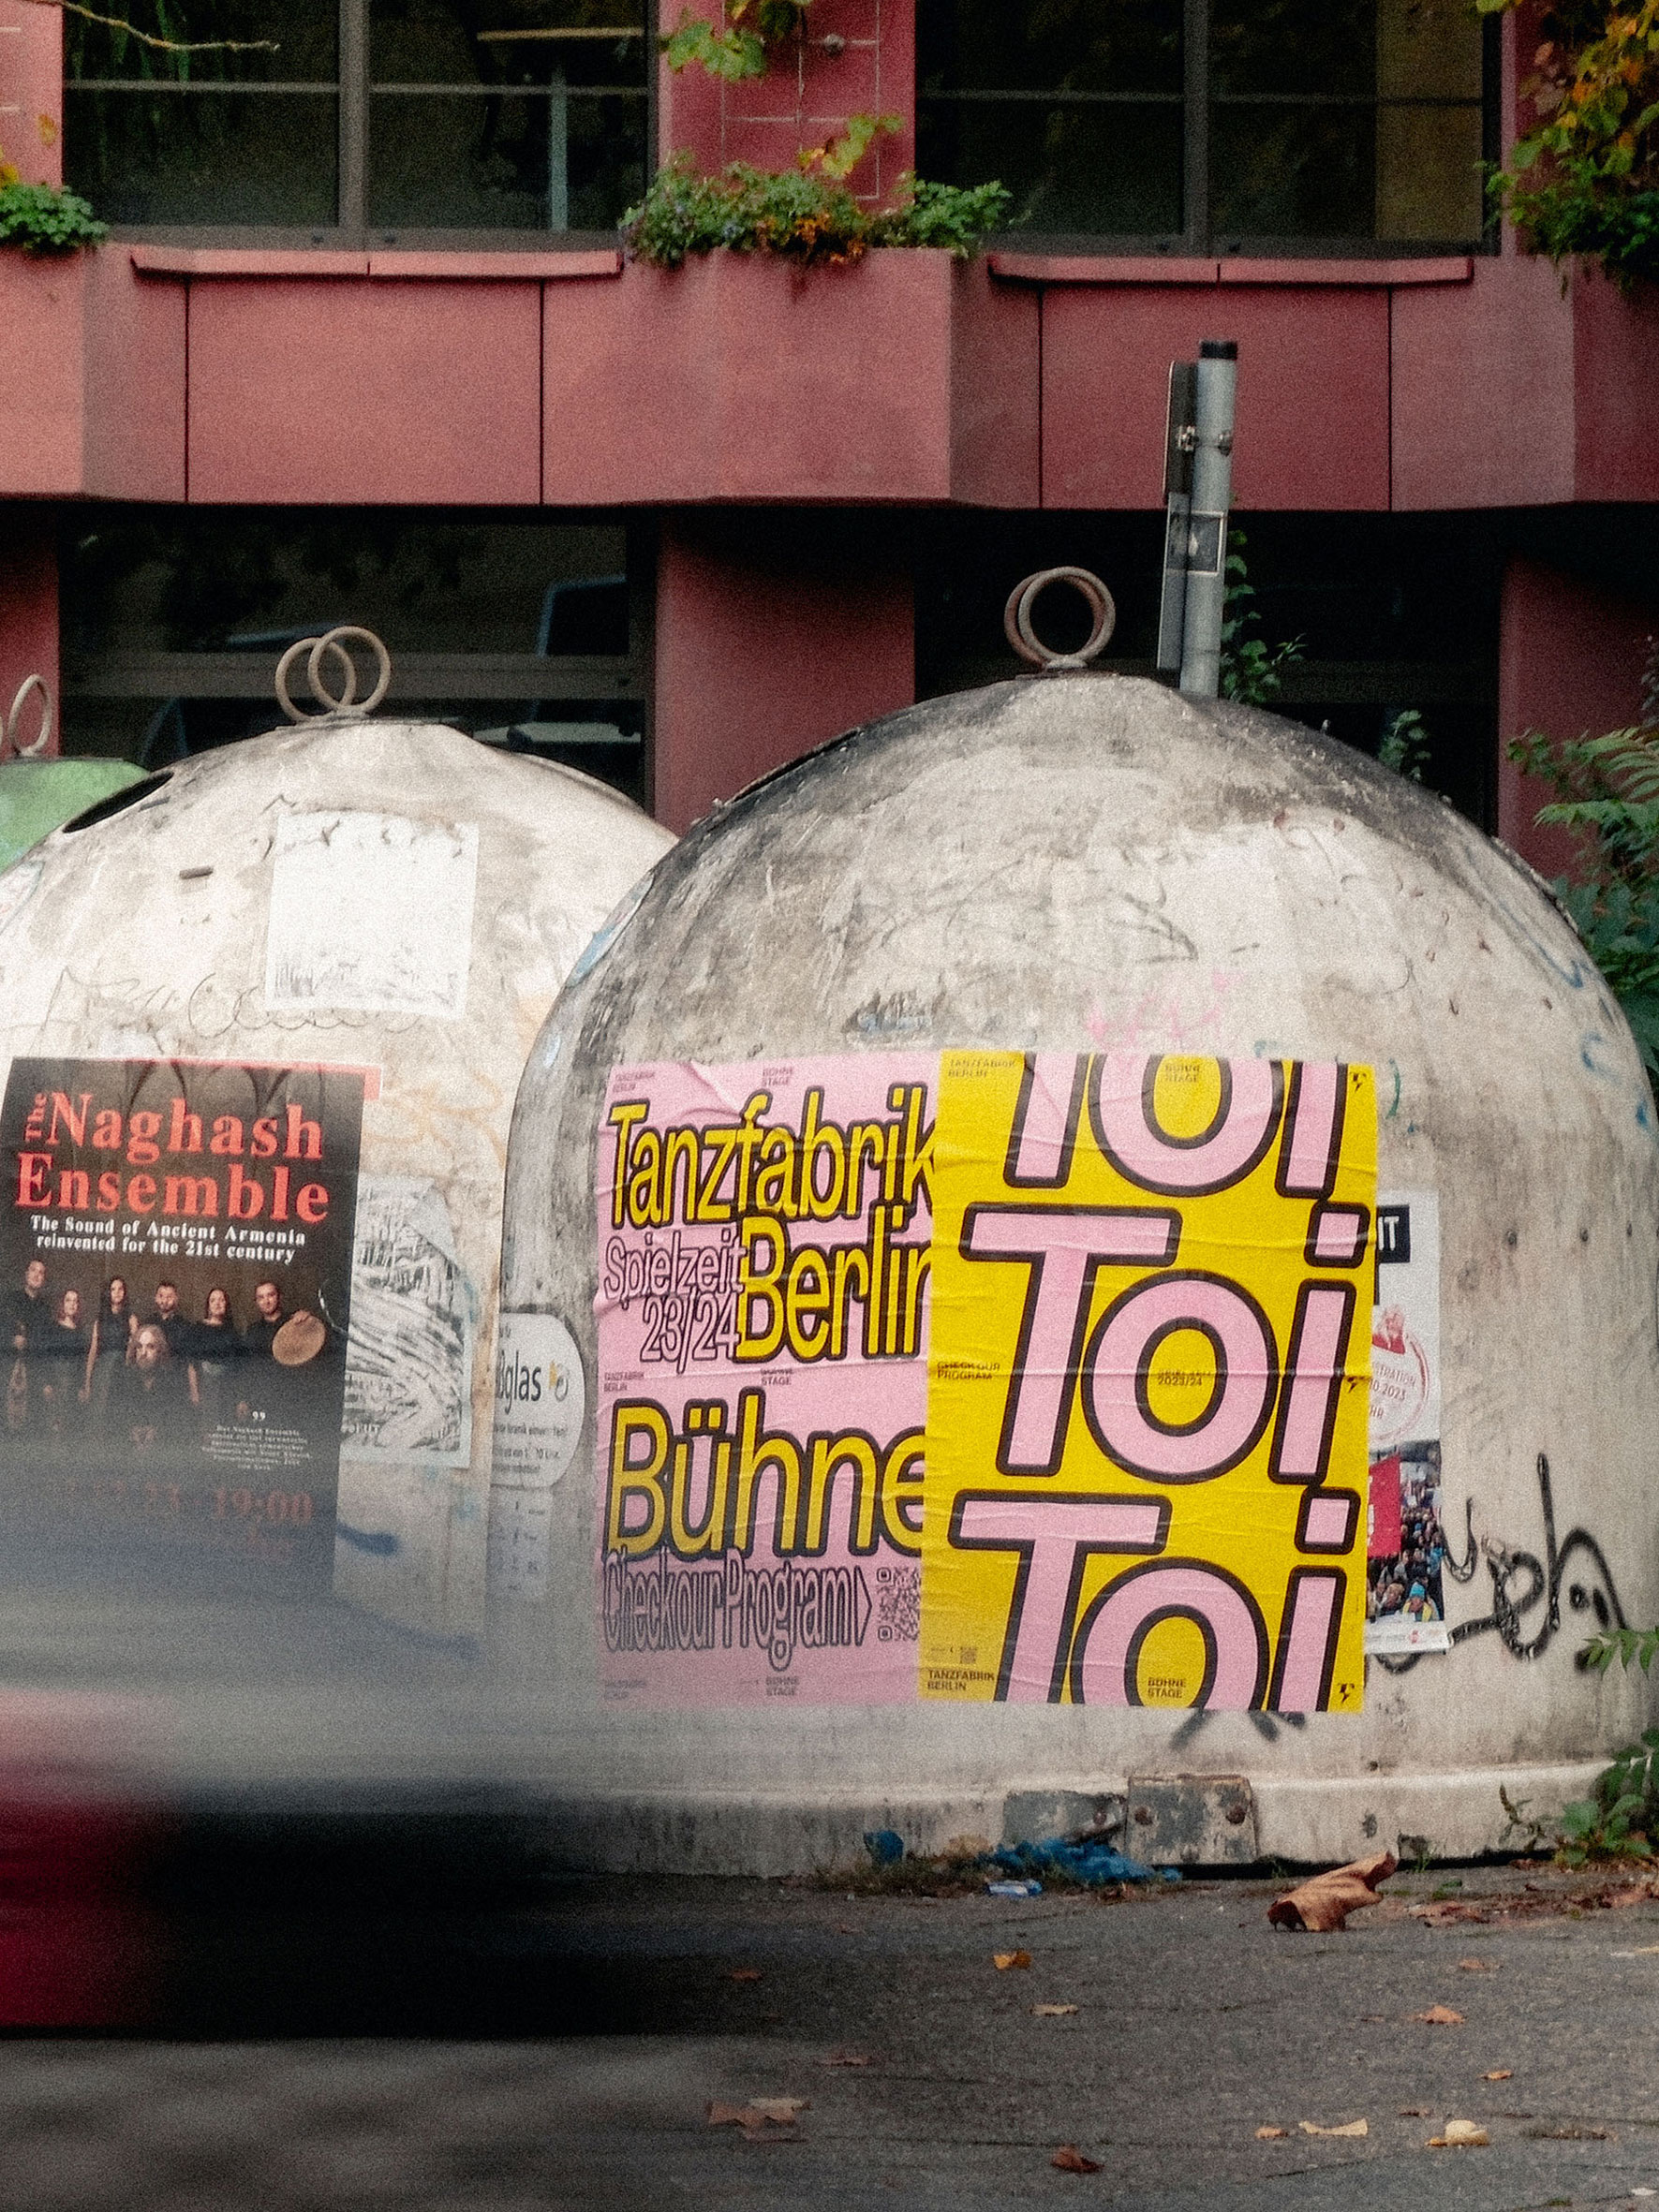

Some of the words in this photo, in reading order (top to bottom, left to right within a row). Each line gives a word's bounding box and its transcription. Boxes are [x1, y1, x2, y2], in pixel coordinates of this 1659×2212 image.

[25, 1092, 47, 1143] The
[47, 1090, 323, 1165] Naghash
[606, 1081, 937, 1230] Tanzfabrik
[15, 1152, 330, 1223] Ensemble
[31, 1215, 59, 1231] The
[66, 1216, 114, 1235] Sound
[123, 1220, 141, 1235] of
[146, 1220, 215, 1240] Ancient
[225, 1225, 306, 1246] Armenia
[37, 1233, 115, 1251] reinvented
[122, 1236, 146, 1253] for
[153, 1239, 178, 1255] the
[185, 1240, 219, 1257] 21st
[227, 1246, 295, 1264] century
[604, 1229, 746, 1310] Spielzeit
[641, 1290, 740, 1374] 23/24
[957, 1201, 1370, 1484] Toi
[602, 1387, 926, 1562] Bühne
[724, 1546, 854, 1672] Program
[948, 1487, 1361, 1712] Toi
[927, 1681, 967, 1691] BERLIN
[928, 1669, 995, 1681] TANZFABRIK
